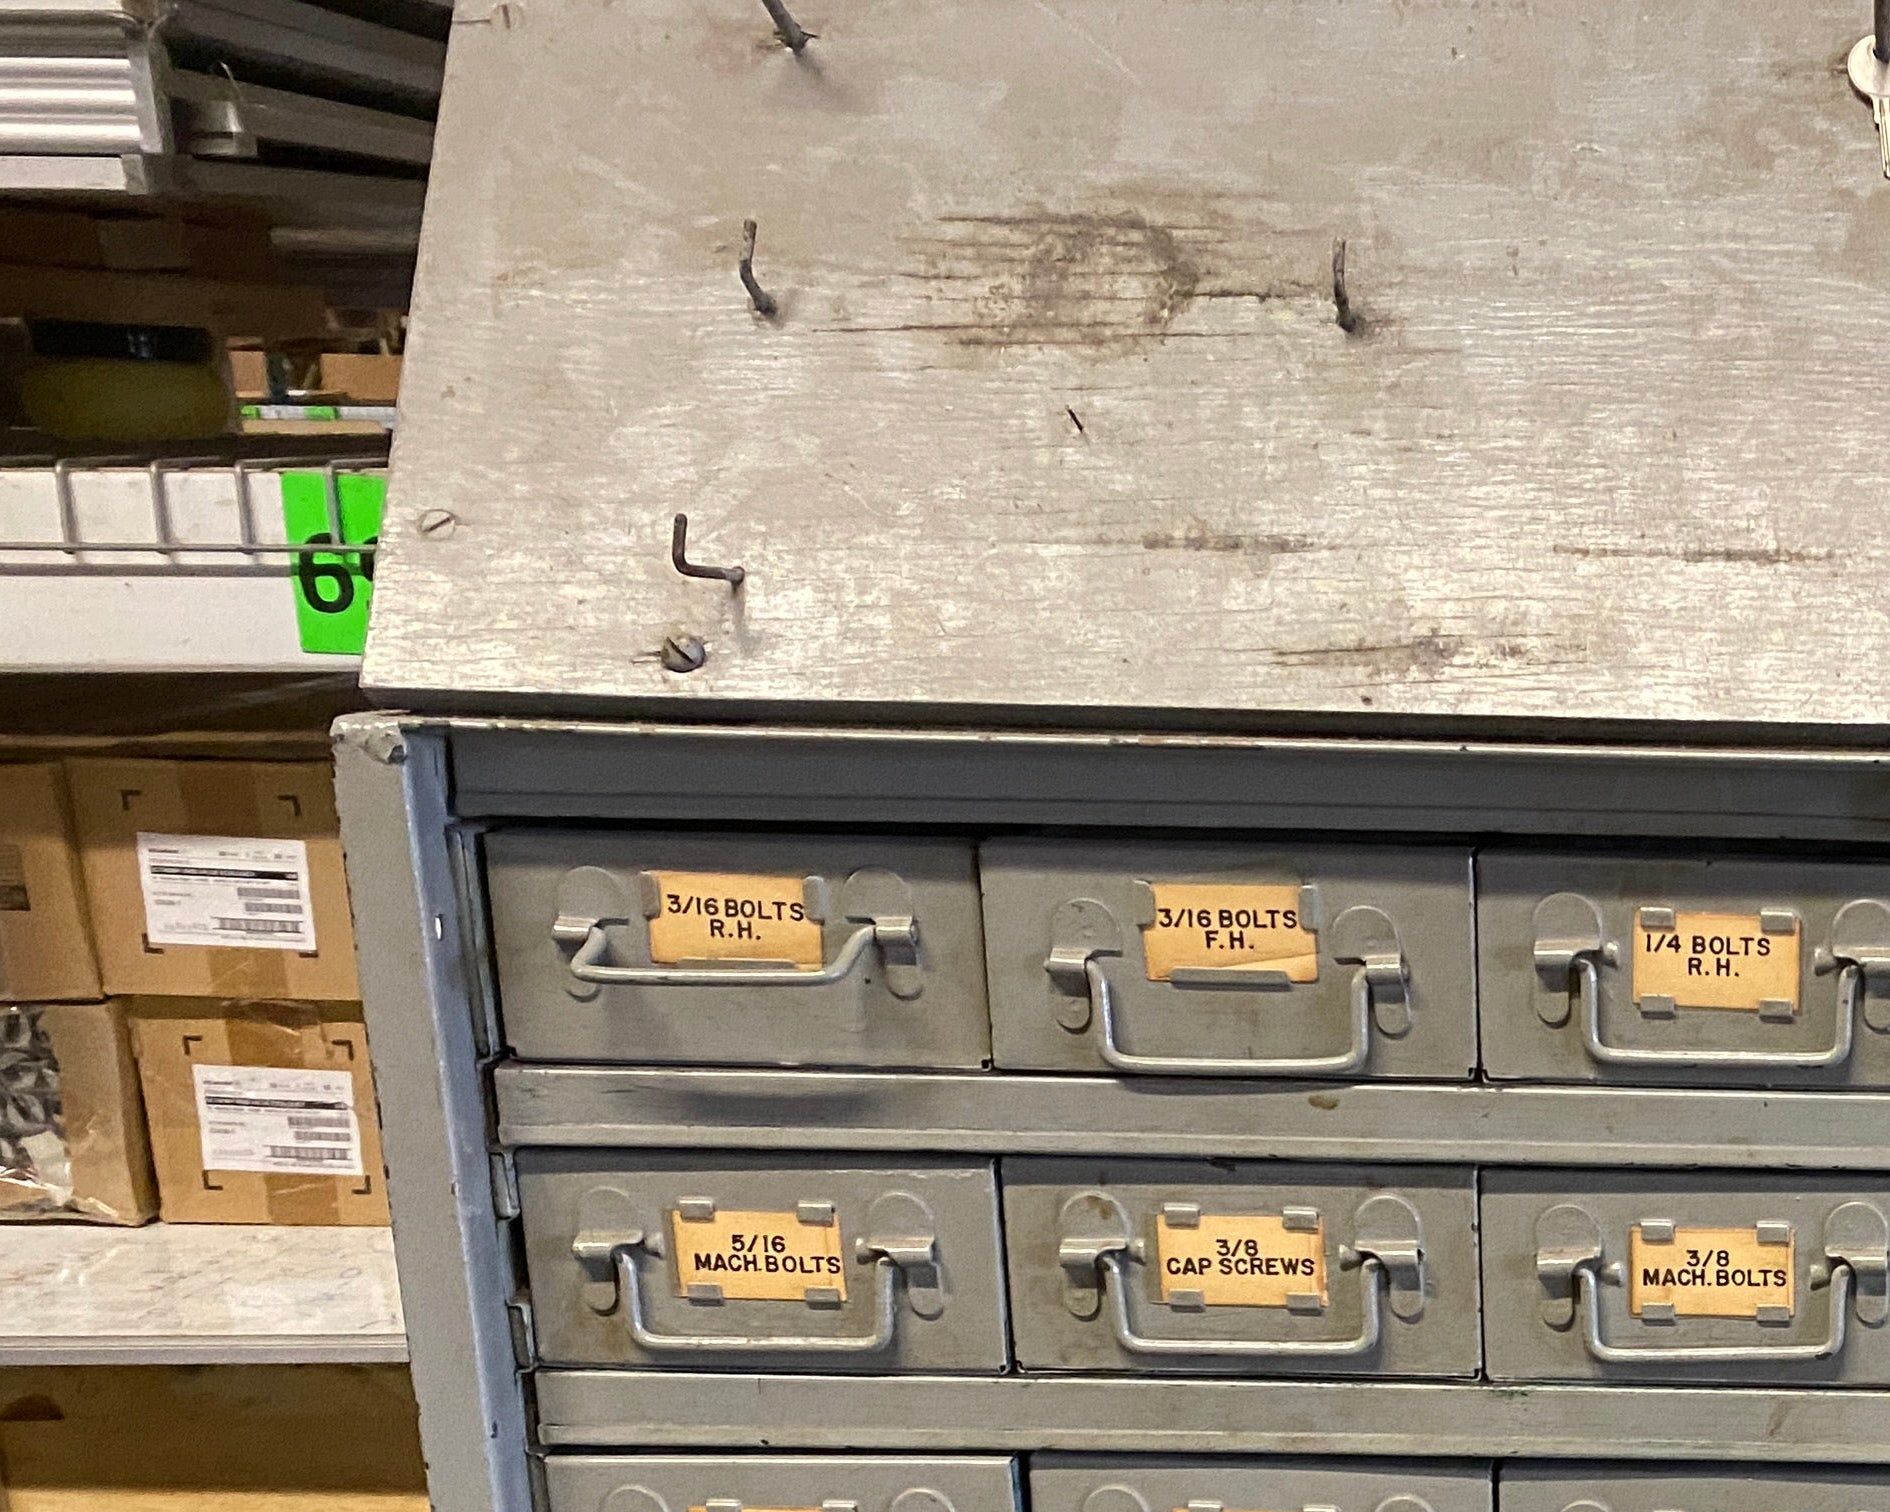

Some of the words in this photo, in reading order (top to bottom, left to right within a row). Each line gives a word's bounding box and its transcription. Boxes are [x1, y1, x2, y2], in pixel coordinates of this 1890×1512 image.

[667, 894, 719, 916] 3/16
[724, 899, 804, 924] BOLTS
[1158, 908, 1211, 928] 3/16
[1219, 910, 1297, 929] BOLTS
[710, 919, 761, 940] R.H.
[1205, 930, 1254, 949] F.H.
[1647, 934, 1681, 953] 1/4
[1692, 936, 1770, 956] BOLTS
[1688, 957, 1739, 977] R.H.
[732, 1234, 785, 1253] 5/16
[1216, 1239, 1260, 1259] 3/8
[1167, 1258, 1212, 1275] CAP
[1219, 1256, 1315, 1276] SCREWS
[1686, 1250, 1729, 1267] 3/8
